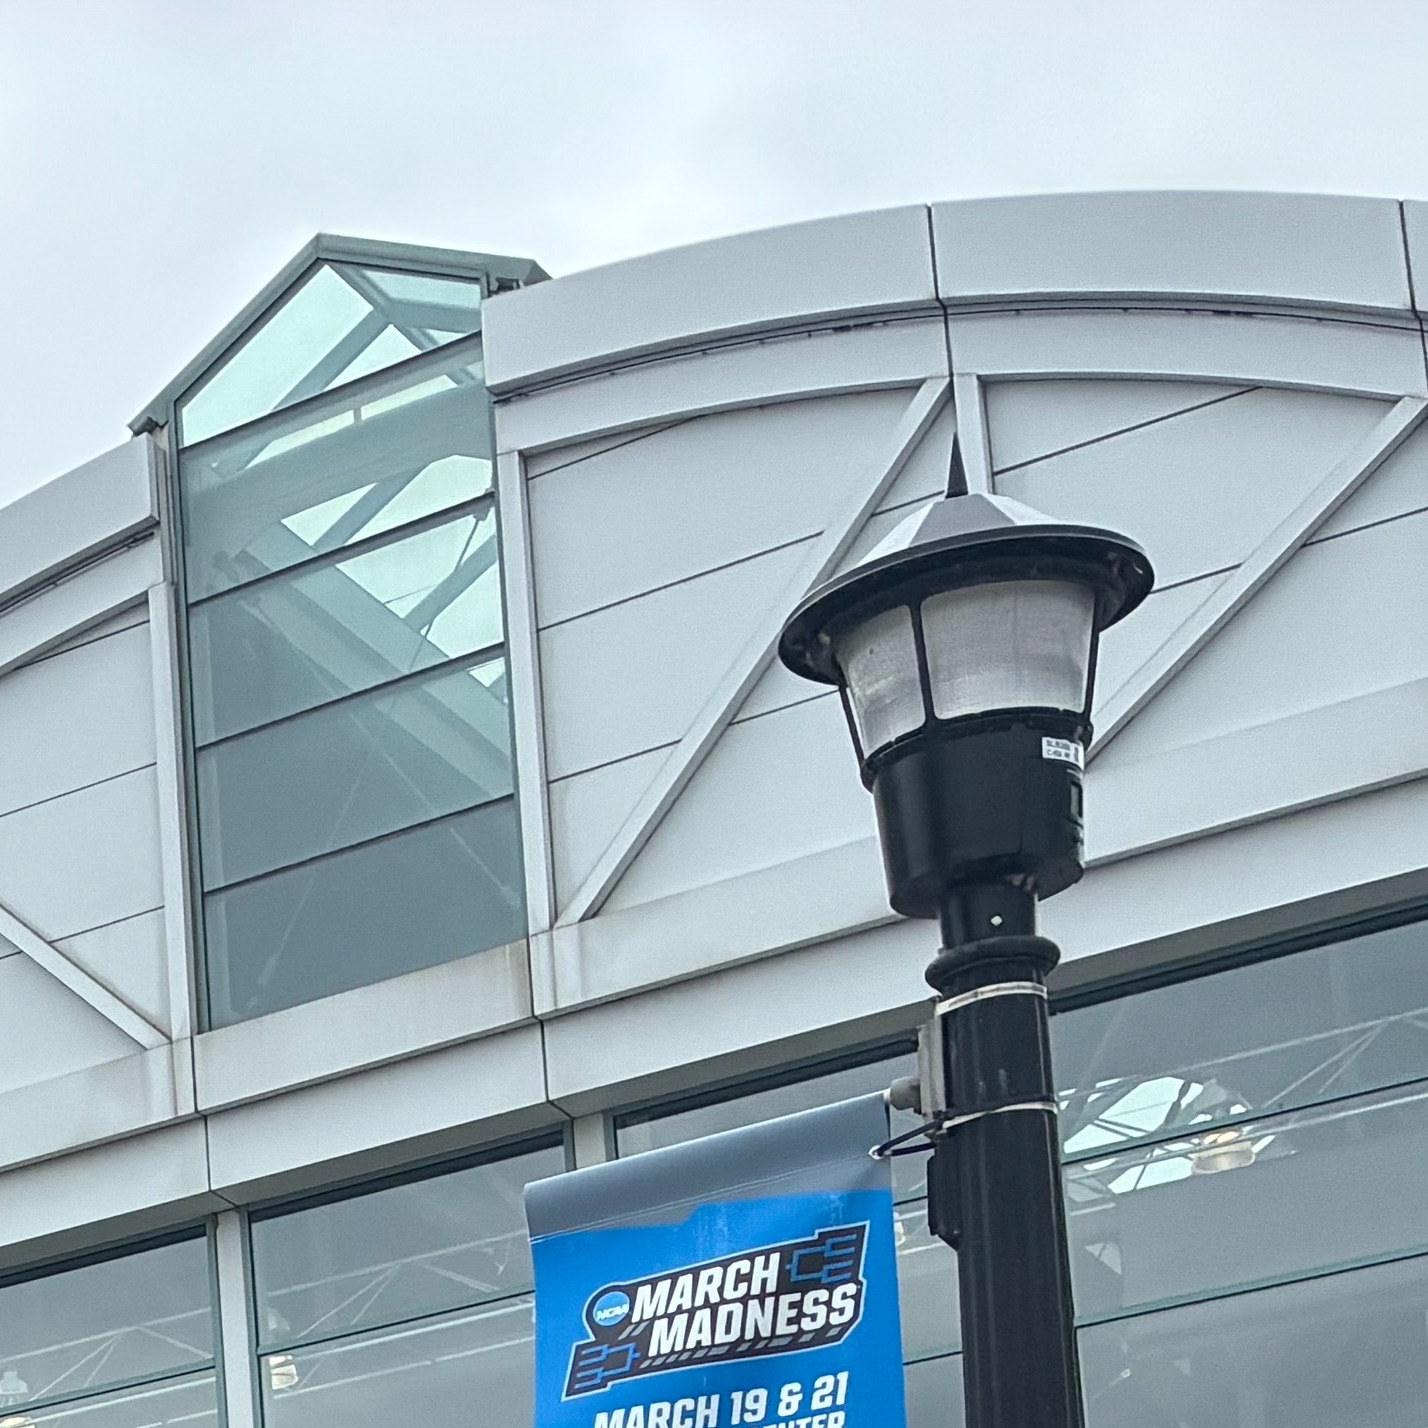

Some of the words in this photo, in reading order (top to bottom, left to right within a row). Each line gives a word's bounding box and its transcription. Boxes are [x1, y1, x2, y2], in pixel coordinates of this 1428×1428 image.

[631, 1252, 781, 1324] MARCH
[648, 1282, 858, 1358] MADNESS
[731, 1387, 769, 1425] 19
[778, 1382, 803, 1418] &
[811, 1371, 849, 1411] 21
